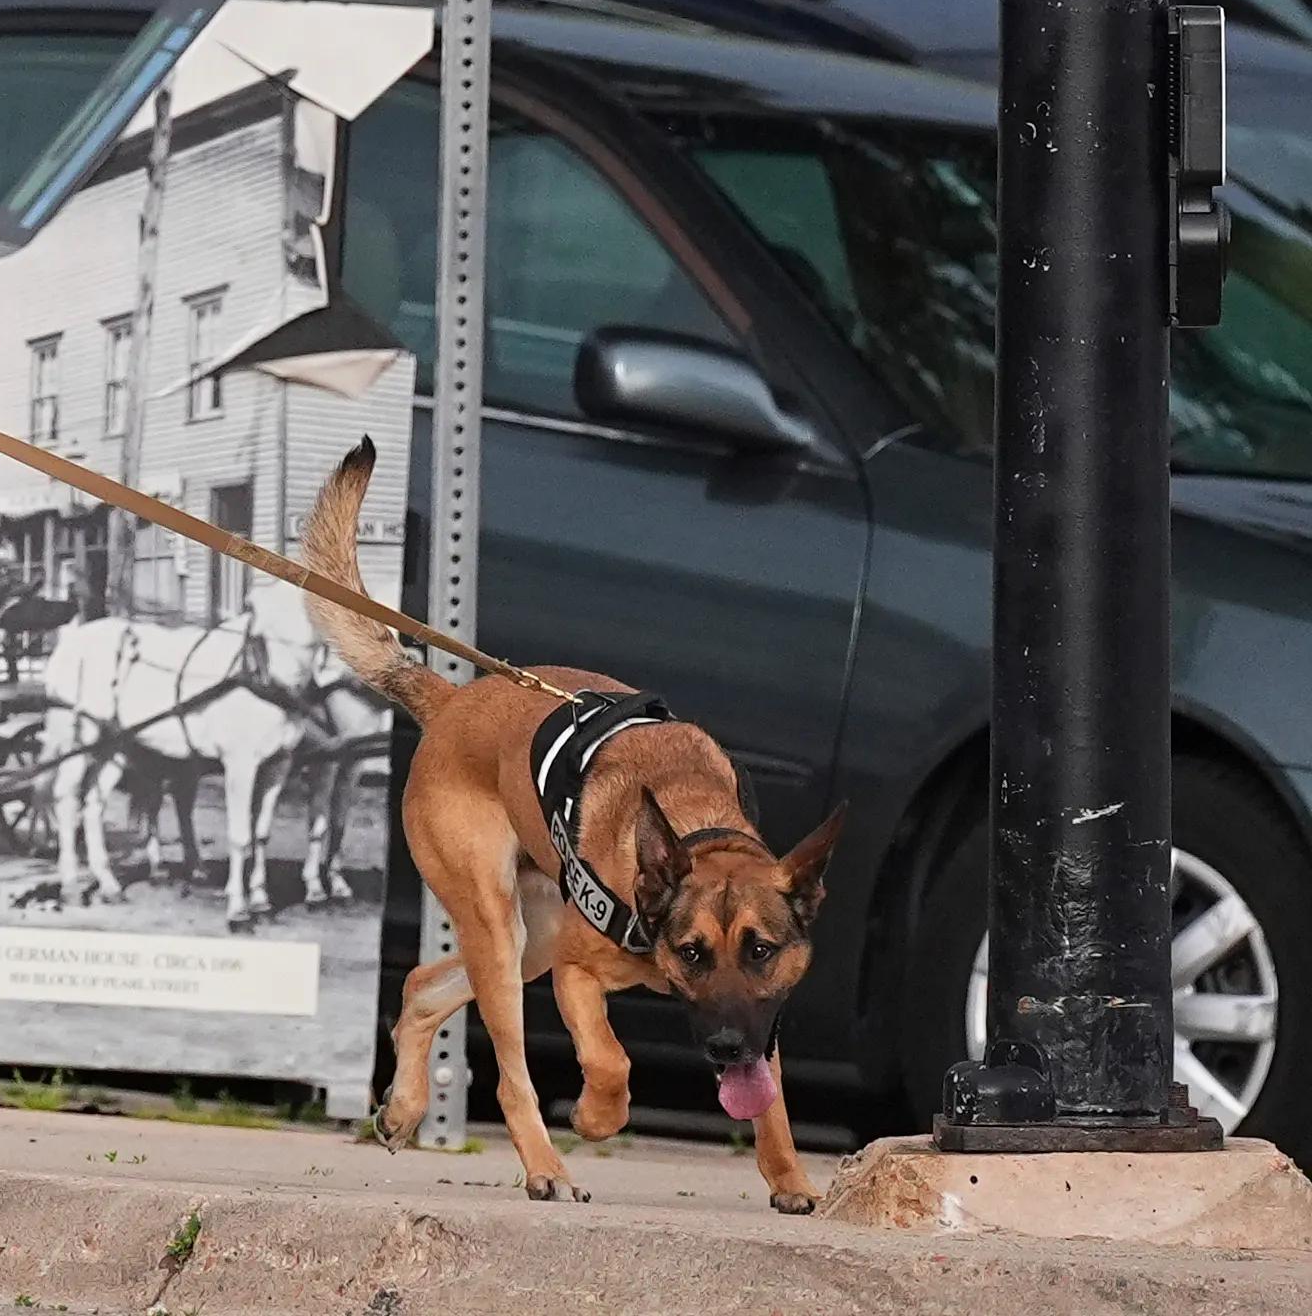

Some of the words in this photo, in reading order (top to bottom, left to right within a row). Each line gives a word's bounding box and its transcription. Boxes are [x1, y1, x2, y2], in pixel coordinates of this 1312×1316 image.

[578, 881, 608, 922] K-9
[5, 945, 79, 964] GERMAN
[84, 949, 141, 967] HOUSE
